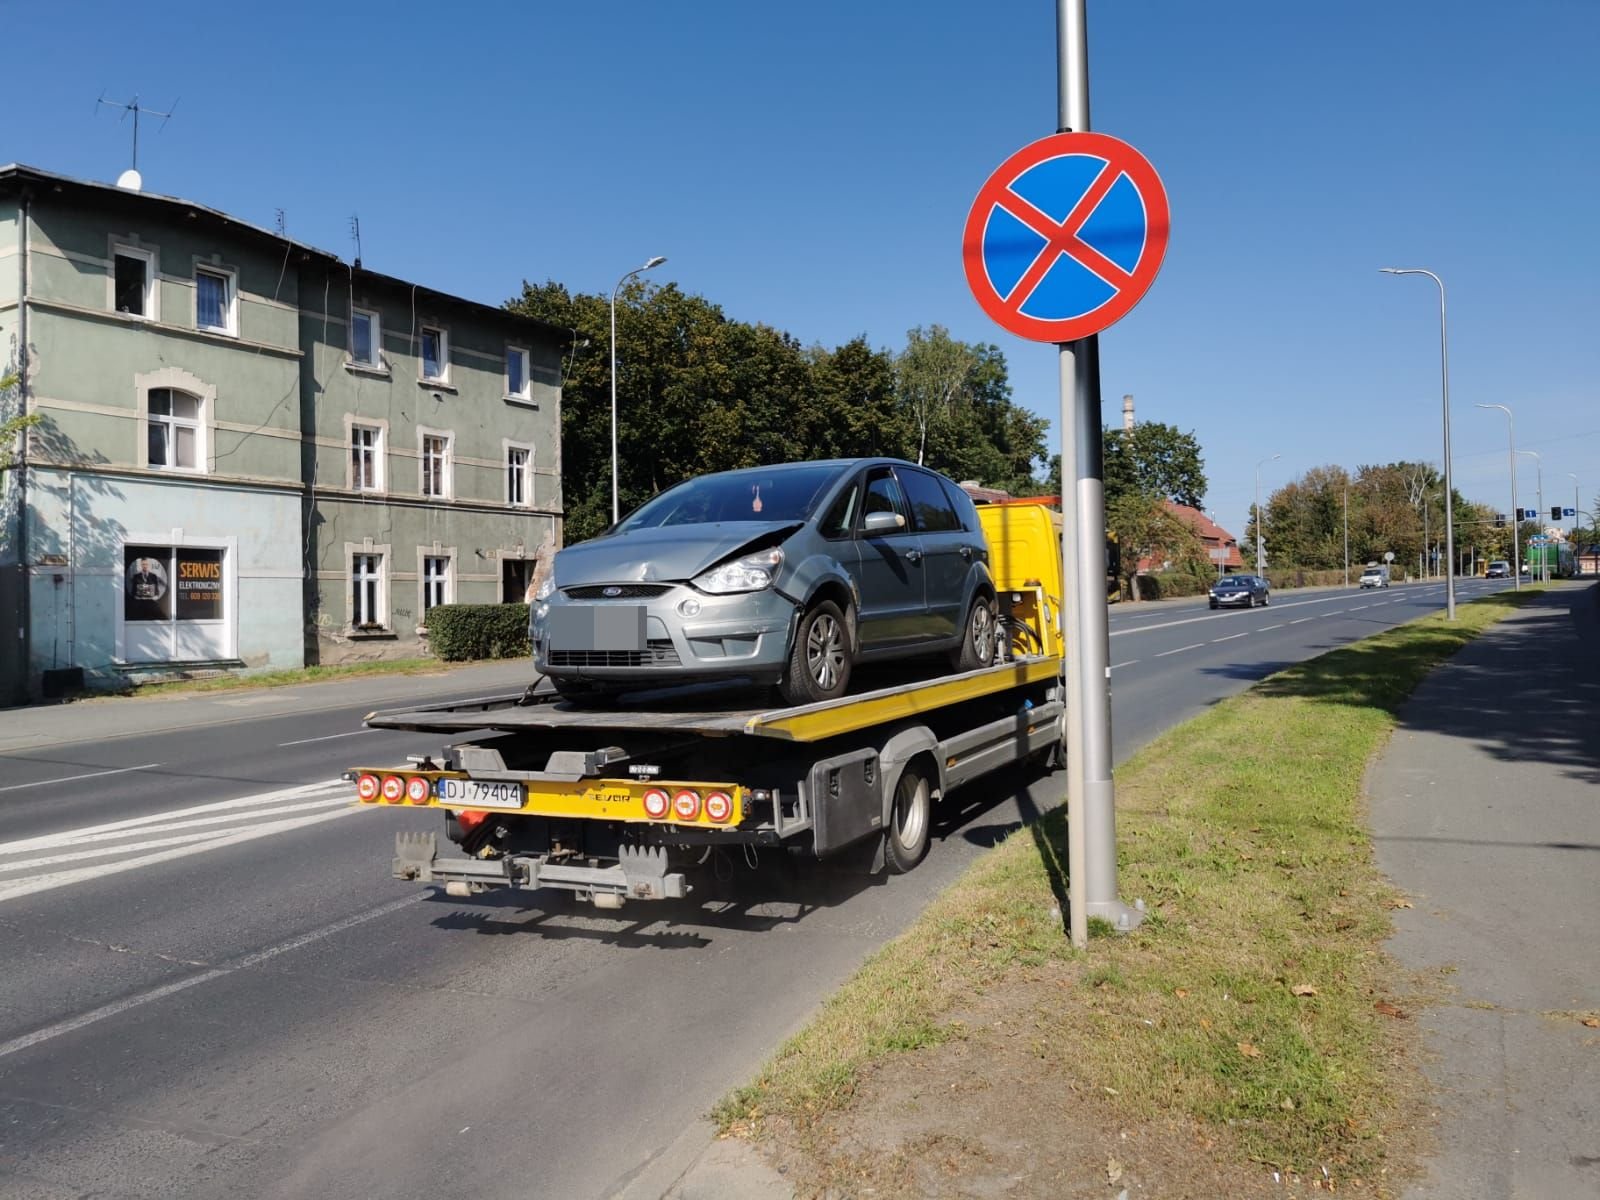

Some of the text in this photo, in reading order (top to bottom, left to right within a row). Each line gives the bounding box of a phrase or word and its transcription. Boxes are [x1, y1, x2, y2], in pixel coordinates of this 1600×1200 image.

[180, 562, 220, 578] SERWIS
[447, 781, 466, 799] DJ
[472, 782, 519, 802] 79404
